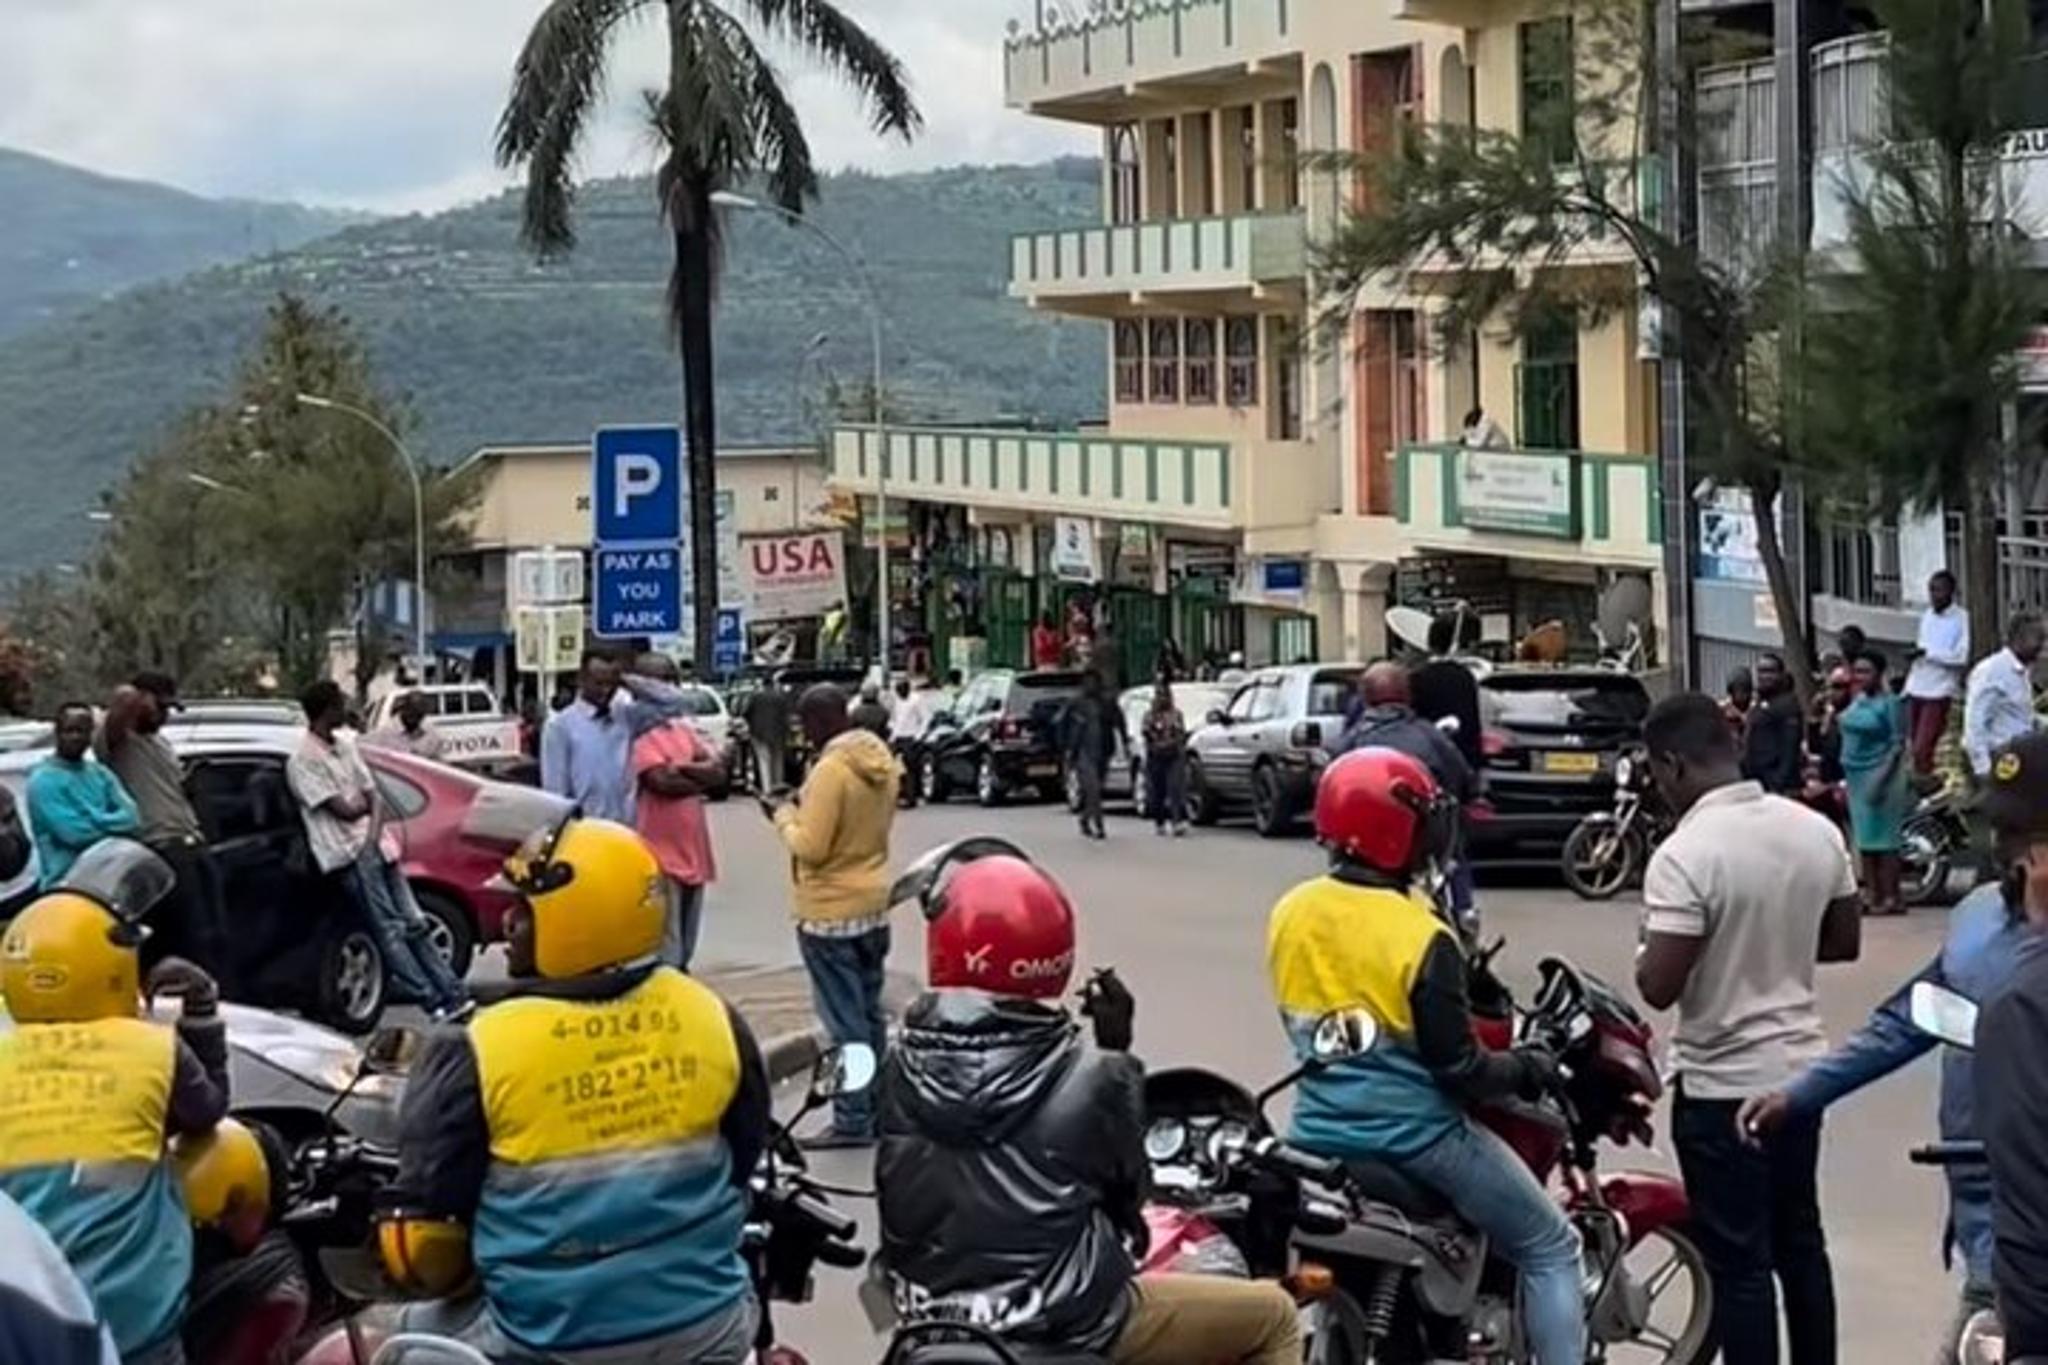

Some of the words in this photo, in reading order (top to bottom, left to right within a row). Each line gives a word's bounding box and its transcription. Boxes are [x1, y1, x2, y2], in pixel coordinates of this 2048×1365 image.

[614, 454, 662, 517] P
[604, 554, 642, 570] PAY
[644, 554, 672, 570] AS
[752, 538, 834, 575] USA
[617, 582, 661, 600] YOU
[612, 611, 667, 629] PARK
[718, 614, 735, 638] P
[439, 736, 501, 753] OYOTA
